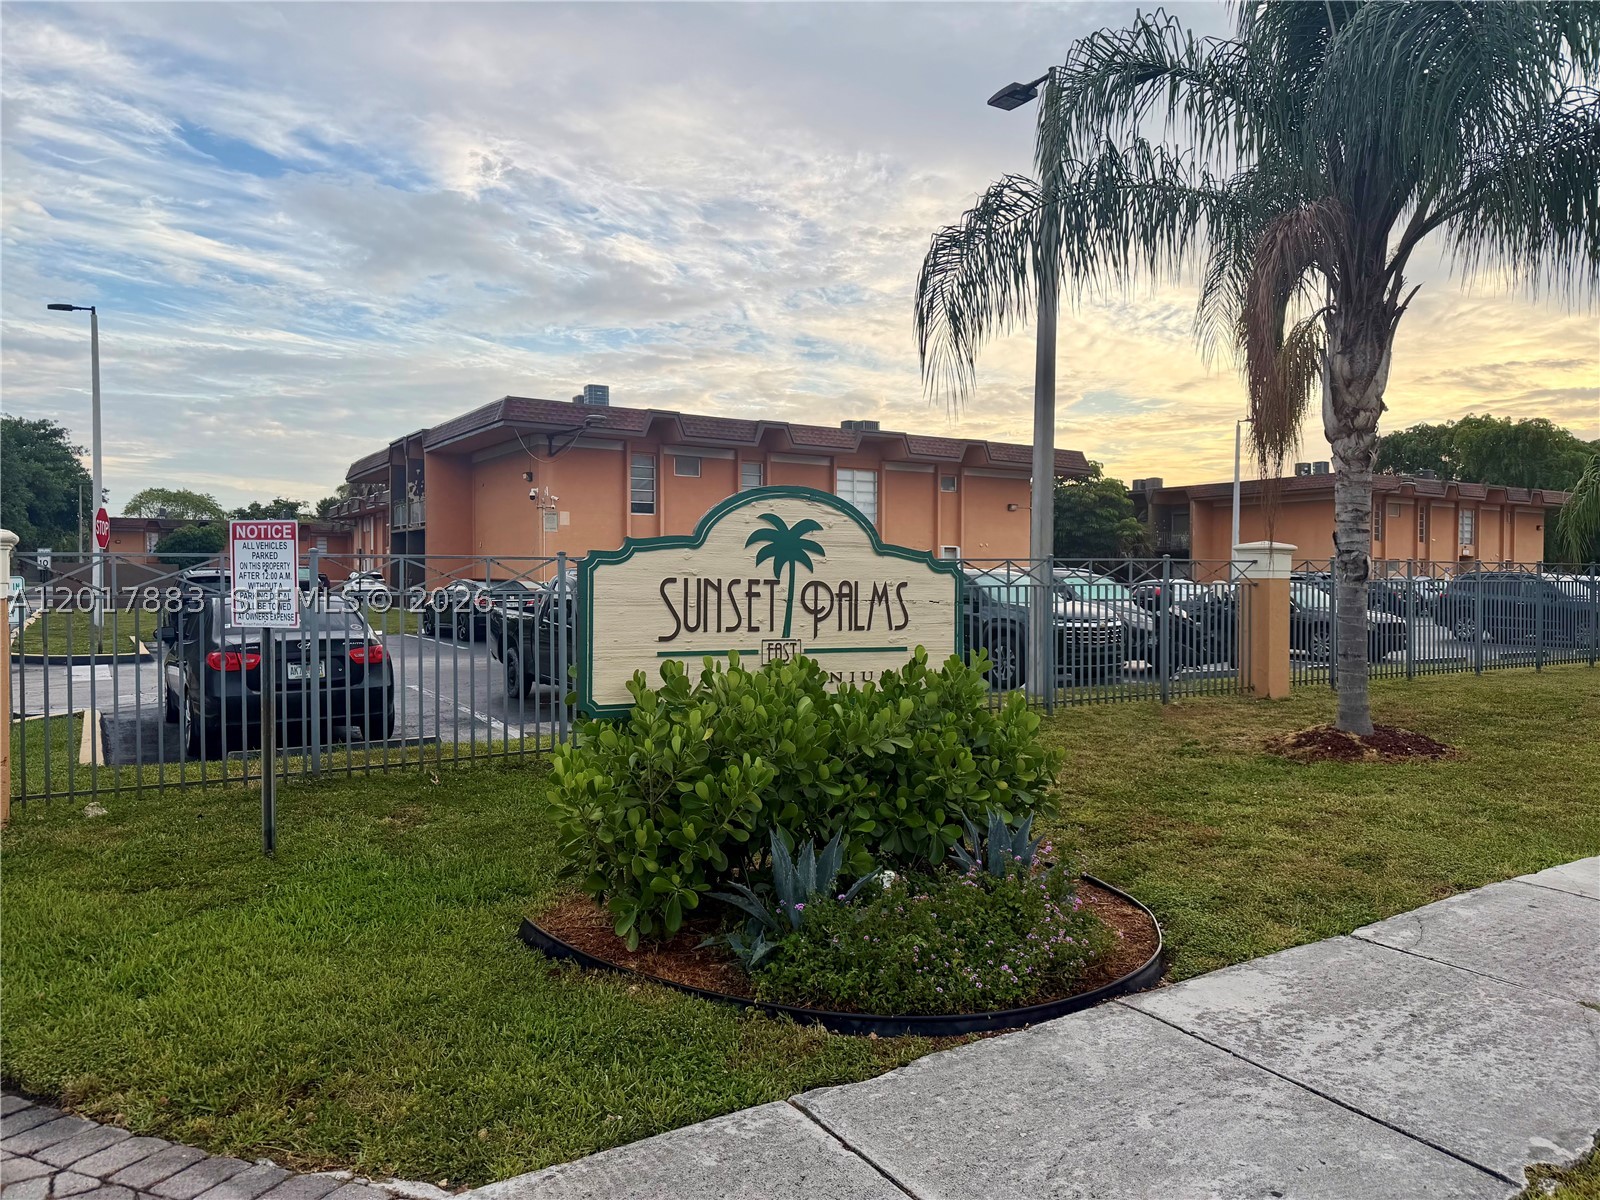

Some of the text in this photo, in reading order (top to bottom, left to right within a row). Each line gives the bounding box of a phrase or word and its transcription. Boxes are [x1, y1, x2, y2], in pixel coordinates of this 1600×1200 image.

[96, 519, 110, 536] STOP
[236, 525, 292, 539] NOTICE
[242, 541, 288, 550] ALL VEHICLES
[251, 552, 279, 560] PARKED
[239, 562, 291, 570] ON THIS PROPERTY
[238, 572, 293, 580] AFTER 12:00 A.M.
[247, 582, 277, 590] WITHOUT
[269, 592, 292, 601] DCAL
[239, 602, 256, 611] WLL
[658, 577, 909, 642] SUNSET PALMS
[245, 612, 269, 621] OWNERS
[270, 613, 295, 622] EXPENSE
[766, 642, 797, 663] EAST
